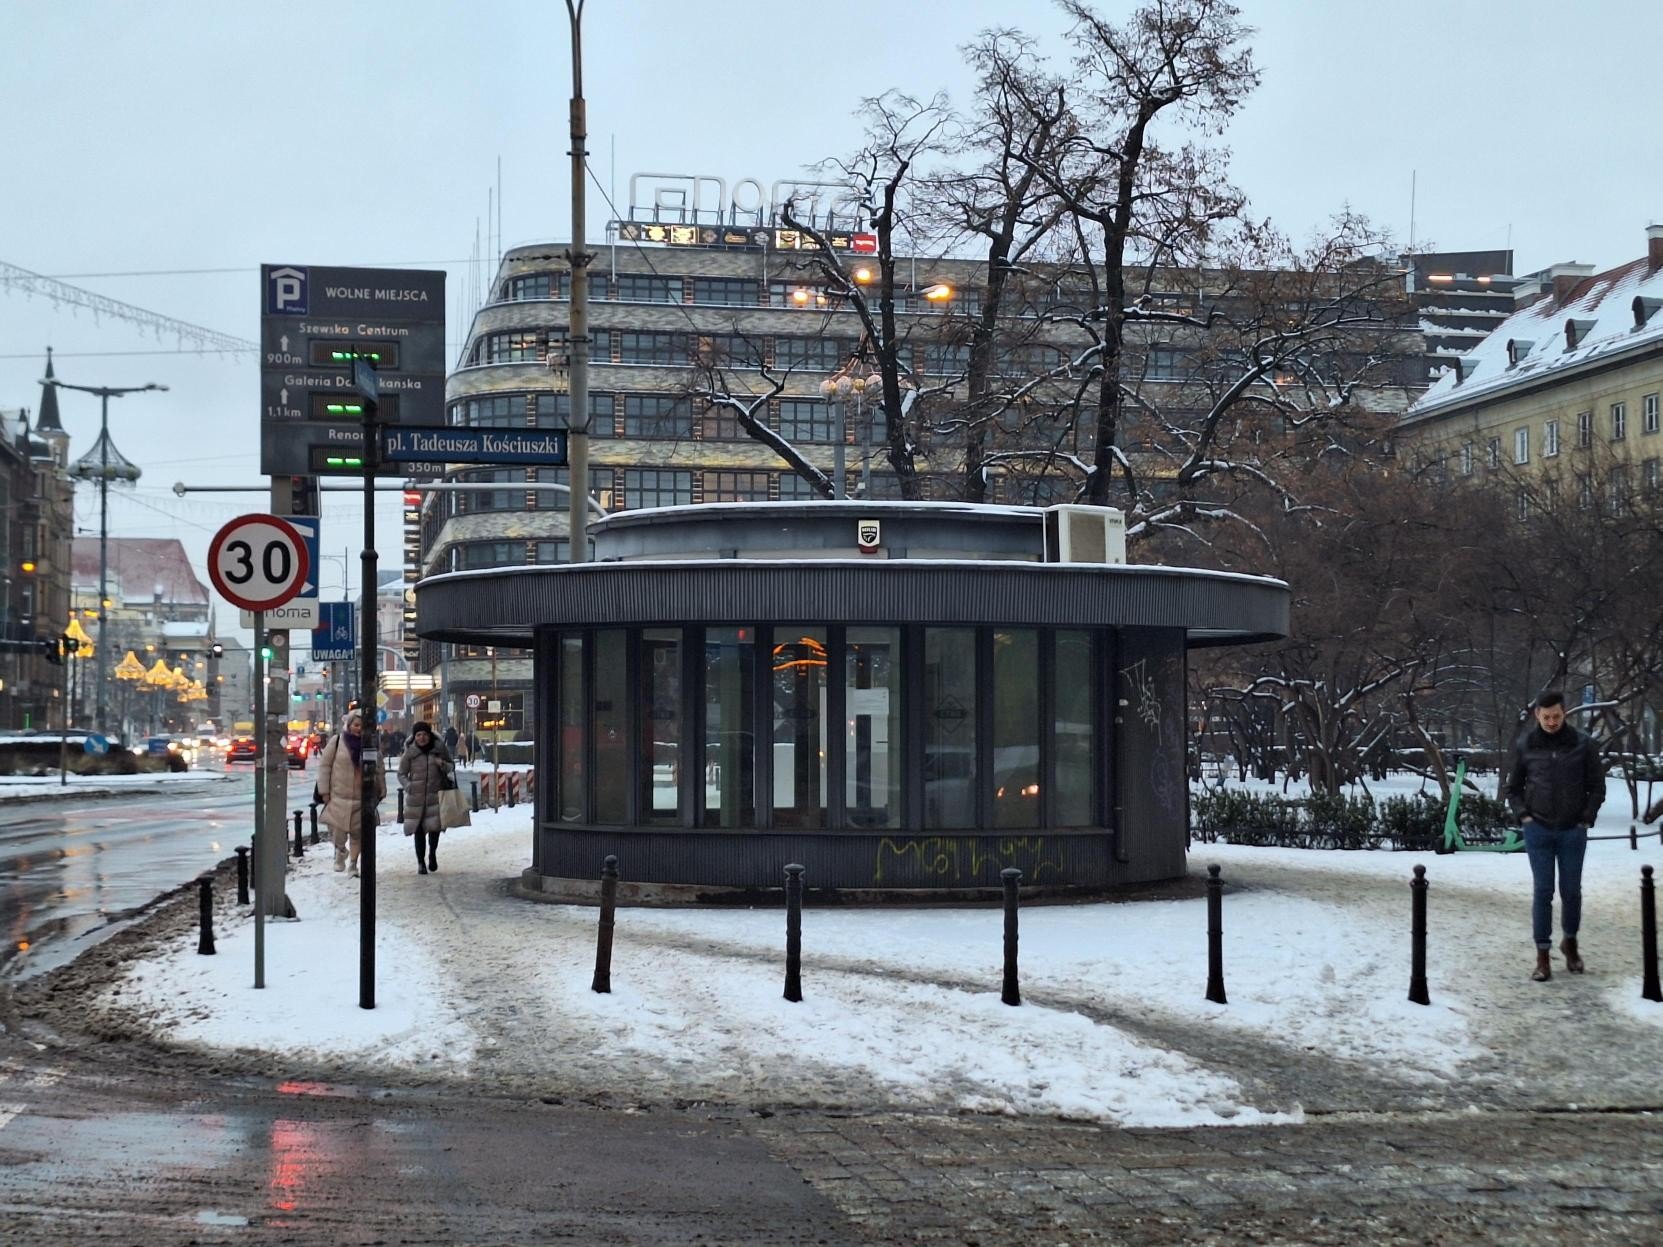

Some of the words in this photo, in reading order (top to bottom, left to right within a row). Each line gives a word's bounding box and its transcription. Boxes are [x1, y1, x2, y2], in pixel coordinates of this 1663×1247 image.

[276, 277, 301, 310] P
[325, 287, 371, 299] WOLNE
[375, 289, 428, 301] MIEJSCA
[357, 324, 409, 337] Centrum
[267, 353, 302, 364] 900m
[284, 375, 331, 387] Galeria
[335, 376, 422, 389] Dokańska
[328, 429, 378, 440] Reno
[387, 433, 406, 454] pl.
[410, 432, 479, 452] Tadeusza
[482, 434, 559, 454] Kościuszki
[408, 463, 442, 472] 350m
[225, 540, 291, 584] 30
[467, 697, 479, 706] 30
